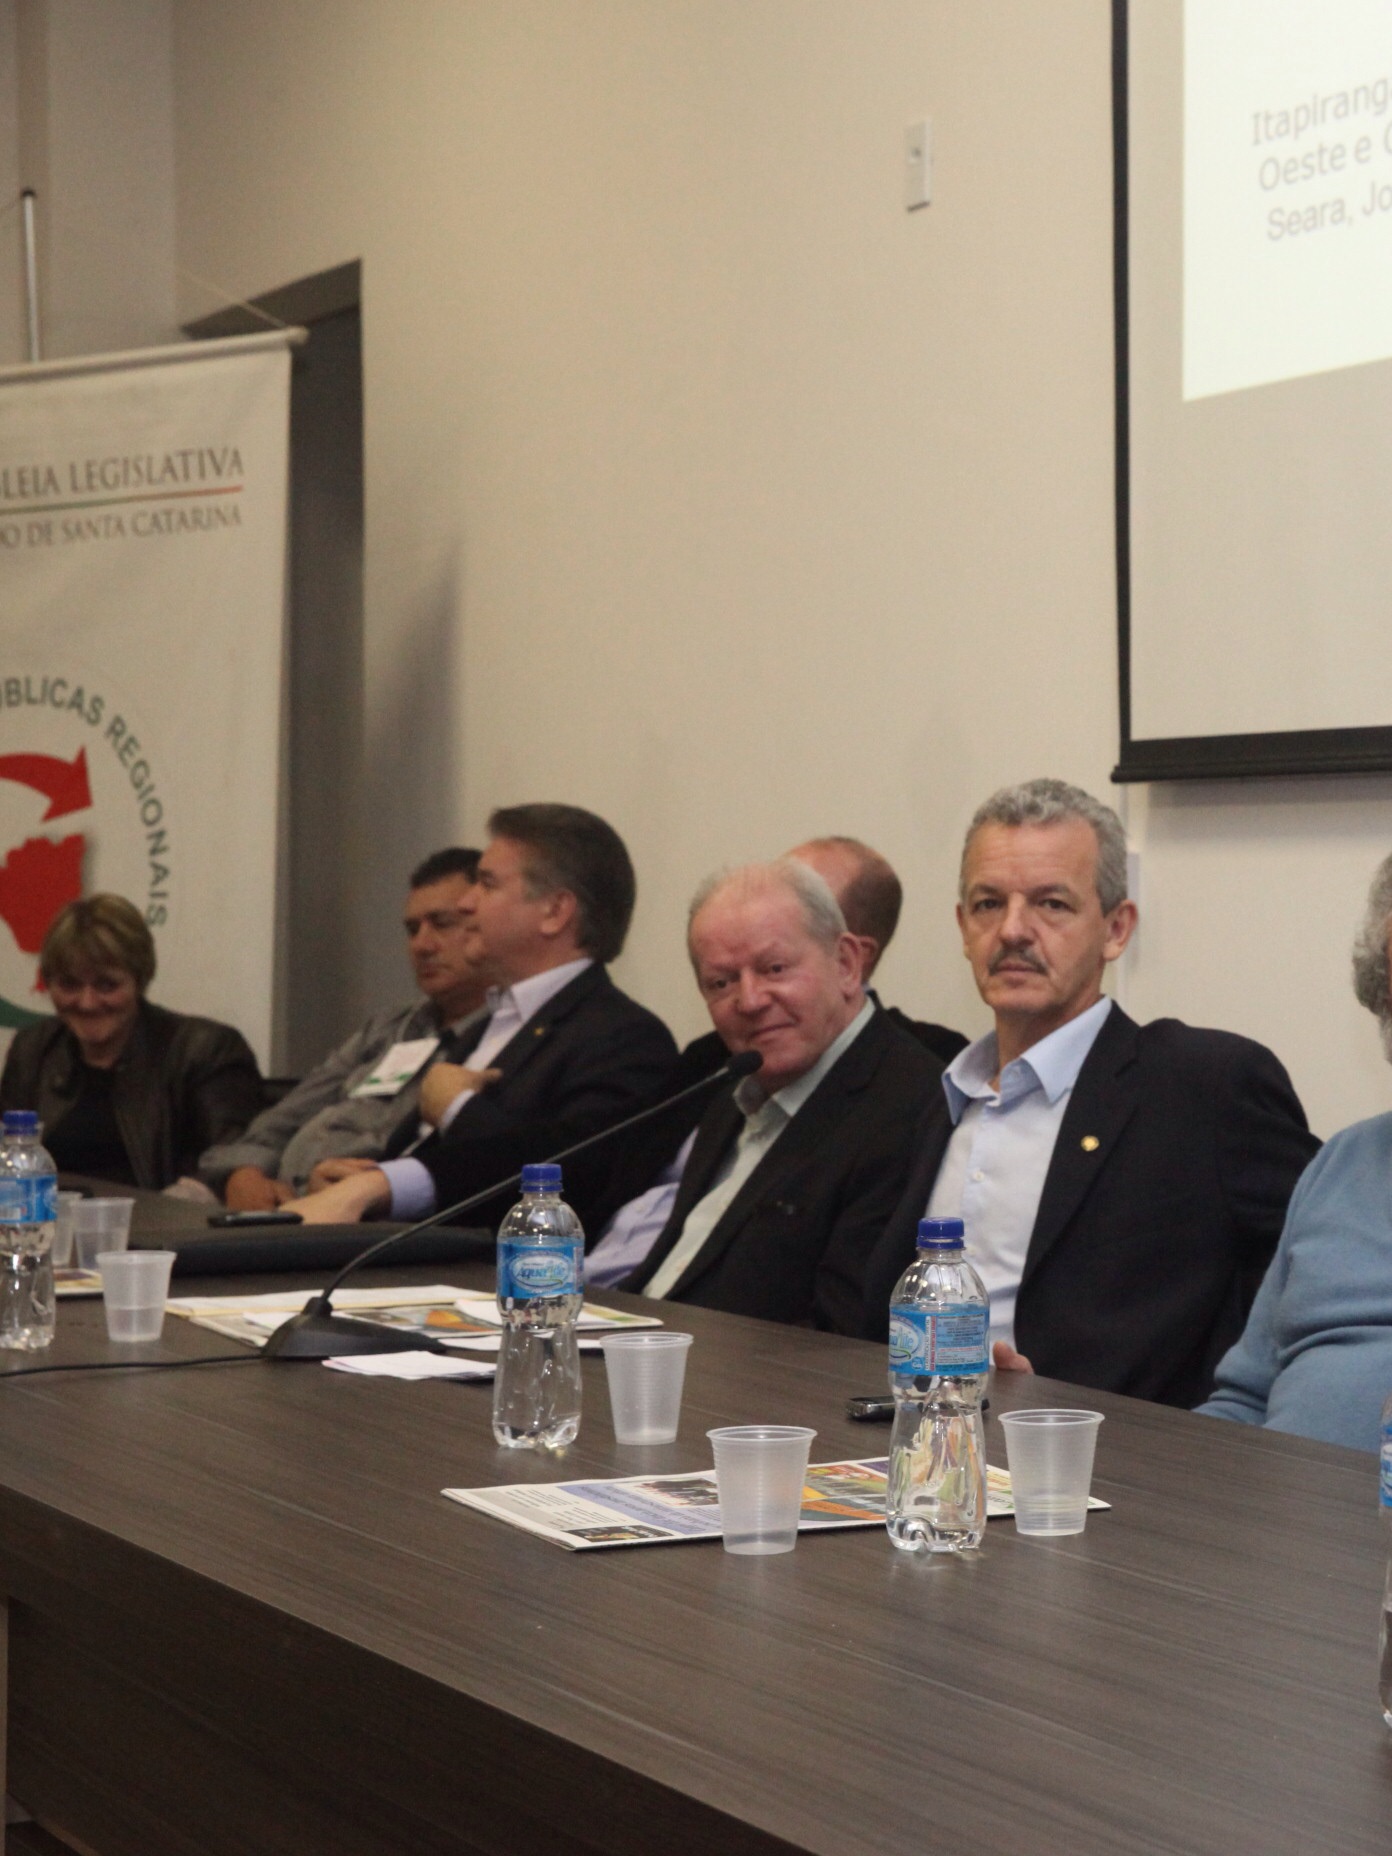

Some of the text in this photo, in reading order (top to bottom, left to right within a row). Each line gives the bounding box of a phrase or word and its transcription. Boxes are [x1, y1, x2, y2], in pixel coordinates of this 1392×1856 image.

[1258, 142, 1347, 192] Oeste
[1353, 135, 1372, 164] e
[1267, 197, 1354, 242] Seara,
[69, 447, 245, 493] LEGISLATIVA
[27, 519, 54, 547] DE
[61, 513, 126, 543] SANTA
[130, 503, 242, 538] CATARINA
[0, 676, 171, 929] BLICAS REGIONAIS
